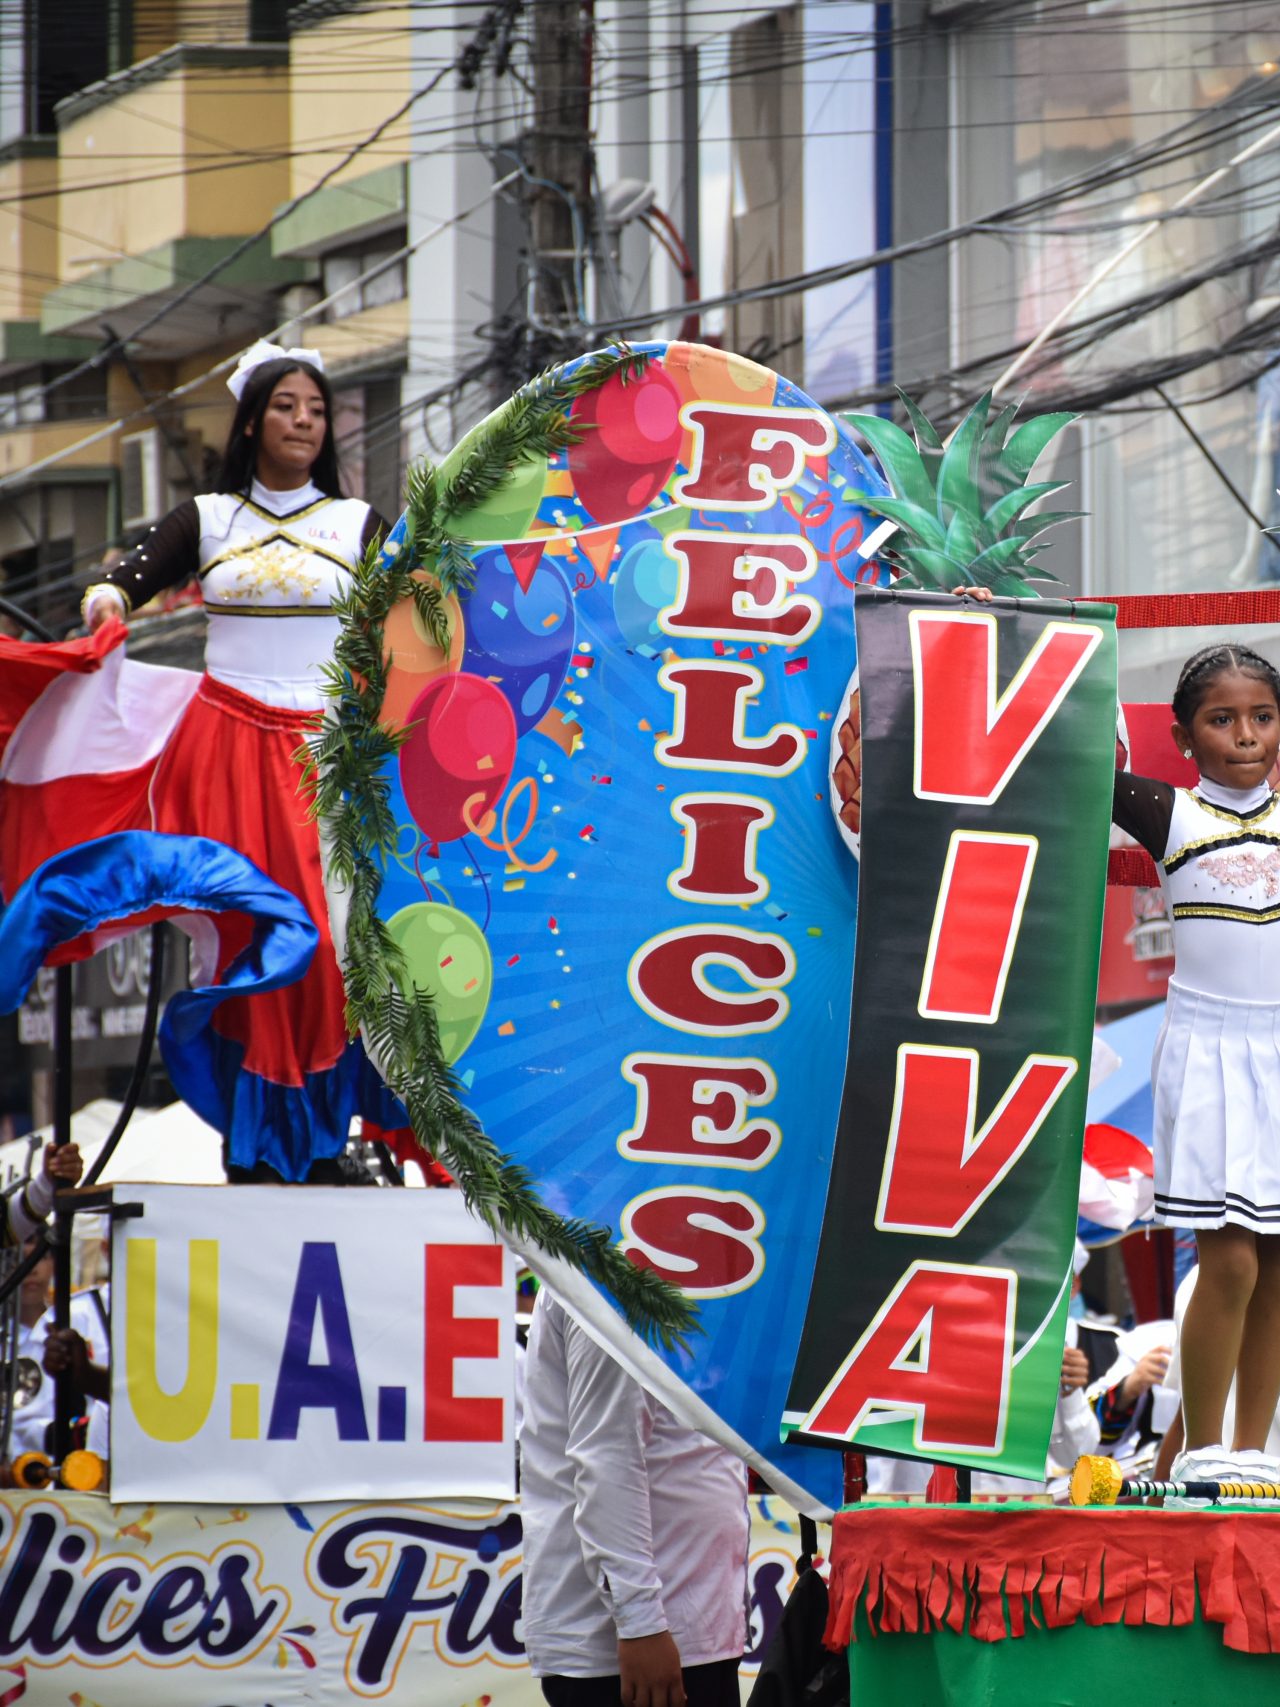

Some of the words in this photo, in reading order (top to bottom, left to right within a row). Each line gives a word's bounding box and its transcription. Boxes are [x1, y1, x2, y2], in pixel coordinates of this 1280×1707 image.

[617, 401, 837, 1299] FELICES
[801, 610, 1103, 1457] VIVA
[0, 1511, 279, 1657] lices
[126, 1238, 504, 1443] U.A.E
